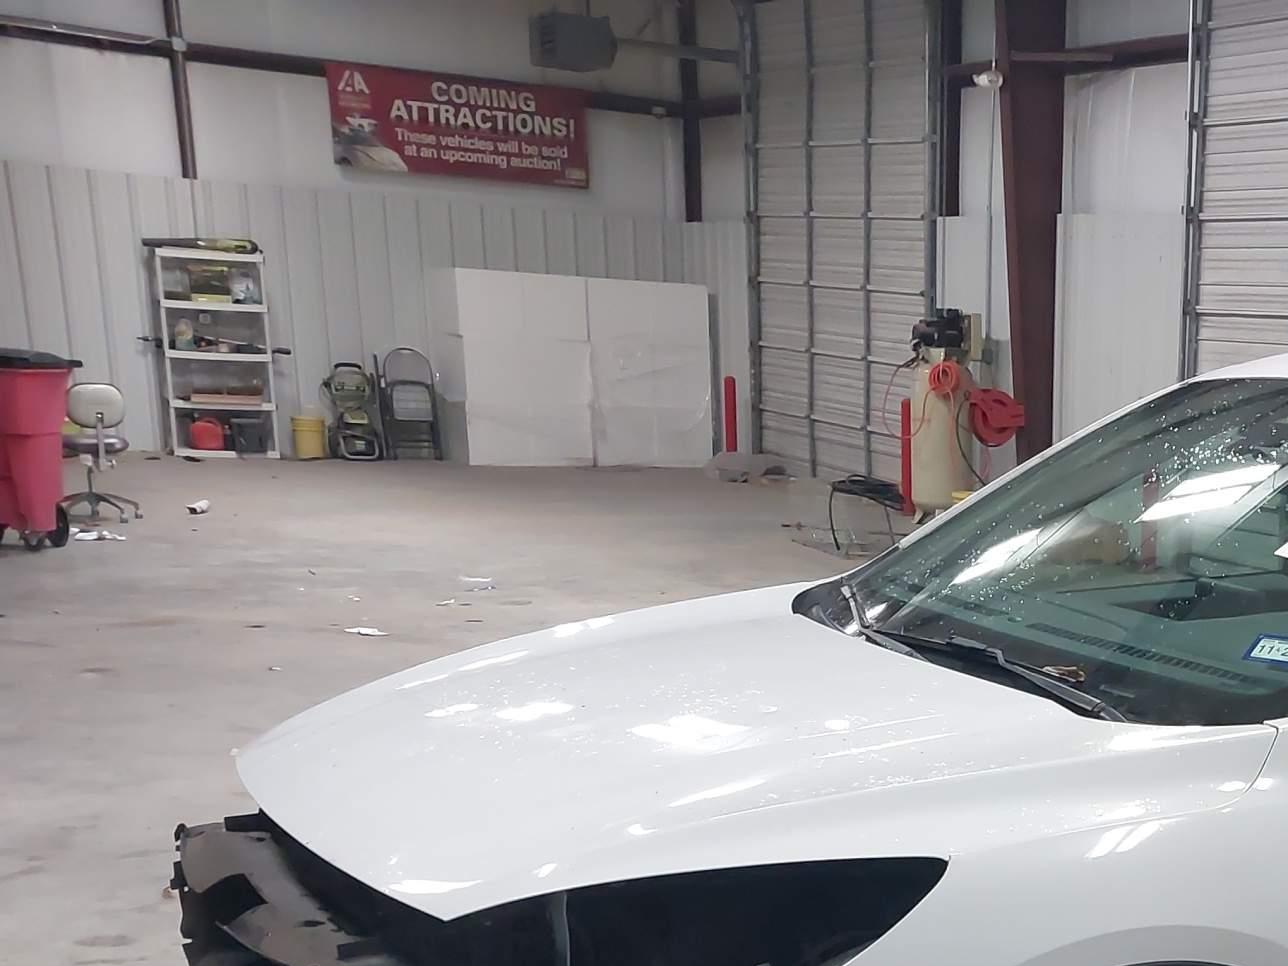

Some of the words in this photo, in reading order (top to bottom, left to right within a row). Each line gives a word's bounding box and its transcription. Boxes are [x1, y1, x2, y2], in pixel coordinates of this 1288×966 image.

[431, 81, 536, 112] COMING
[389, 98, 575, 140] ATTRACTIONS!
[395, 127, 437, 145] These
[440, 134, 494, 151] vehicles
[496, 140, 519, 153] will
[521, 141, 538, 155] be
[542, 145, 568, 158] sold
[404, 144, 417, 157] at
[420, 147, 438, 159] an
[440, 150, 507, 169] upcoming
[510, 156, 561, 171] auction!
